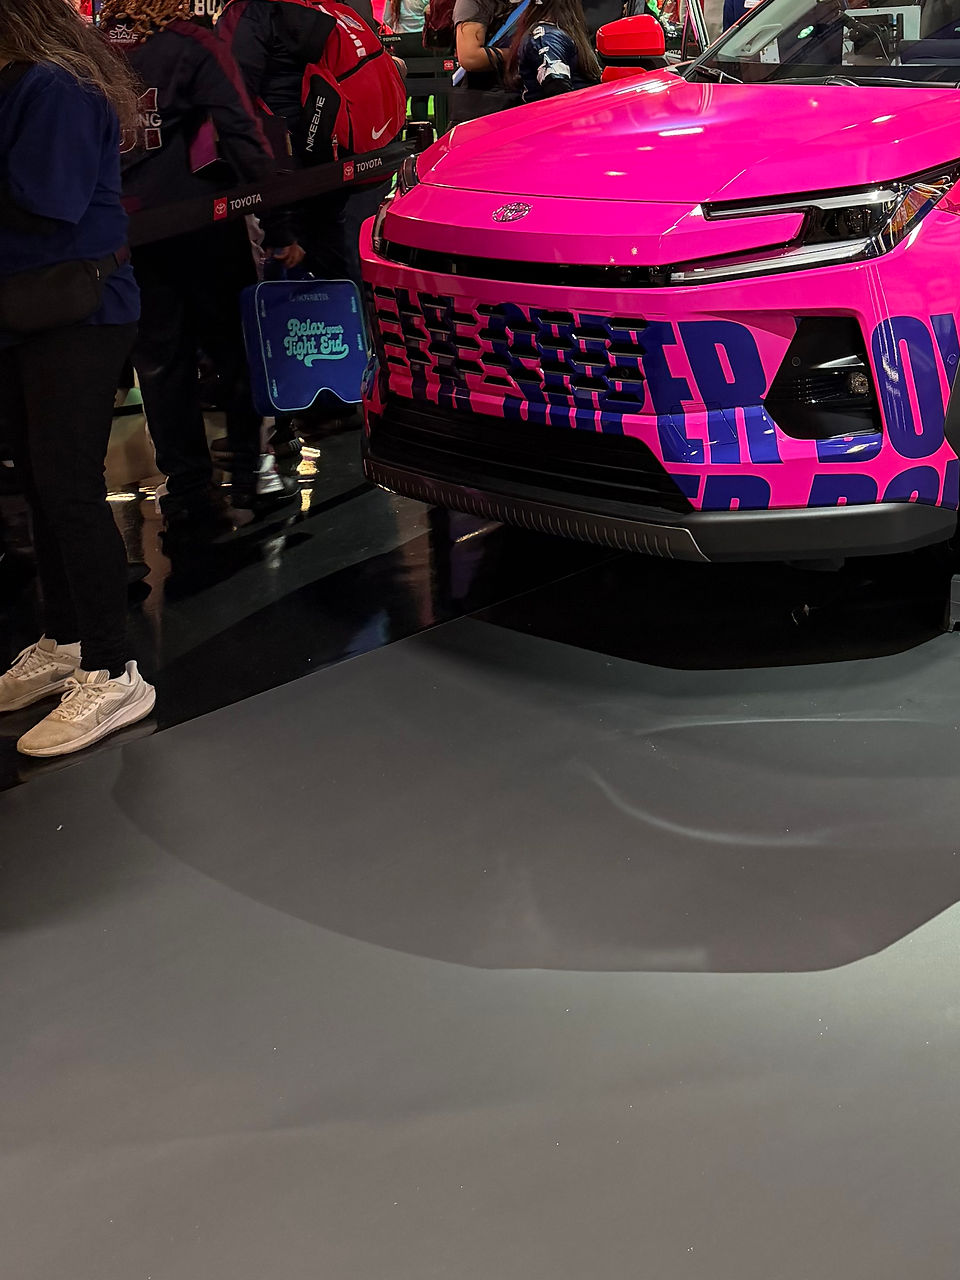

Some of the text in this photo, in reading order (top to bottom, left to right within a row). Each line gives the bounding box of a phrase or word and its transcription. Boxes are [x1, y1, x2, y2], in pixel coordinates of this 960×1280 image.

[356, 157, 383, 172] TOYOTA
[230, 193, 262, 210] TOYOTA
[287, 318, 327, 336] Relax
[284, 335, 318, 361] Tight
[320, 334, 349, 356] End
